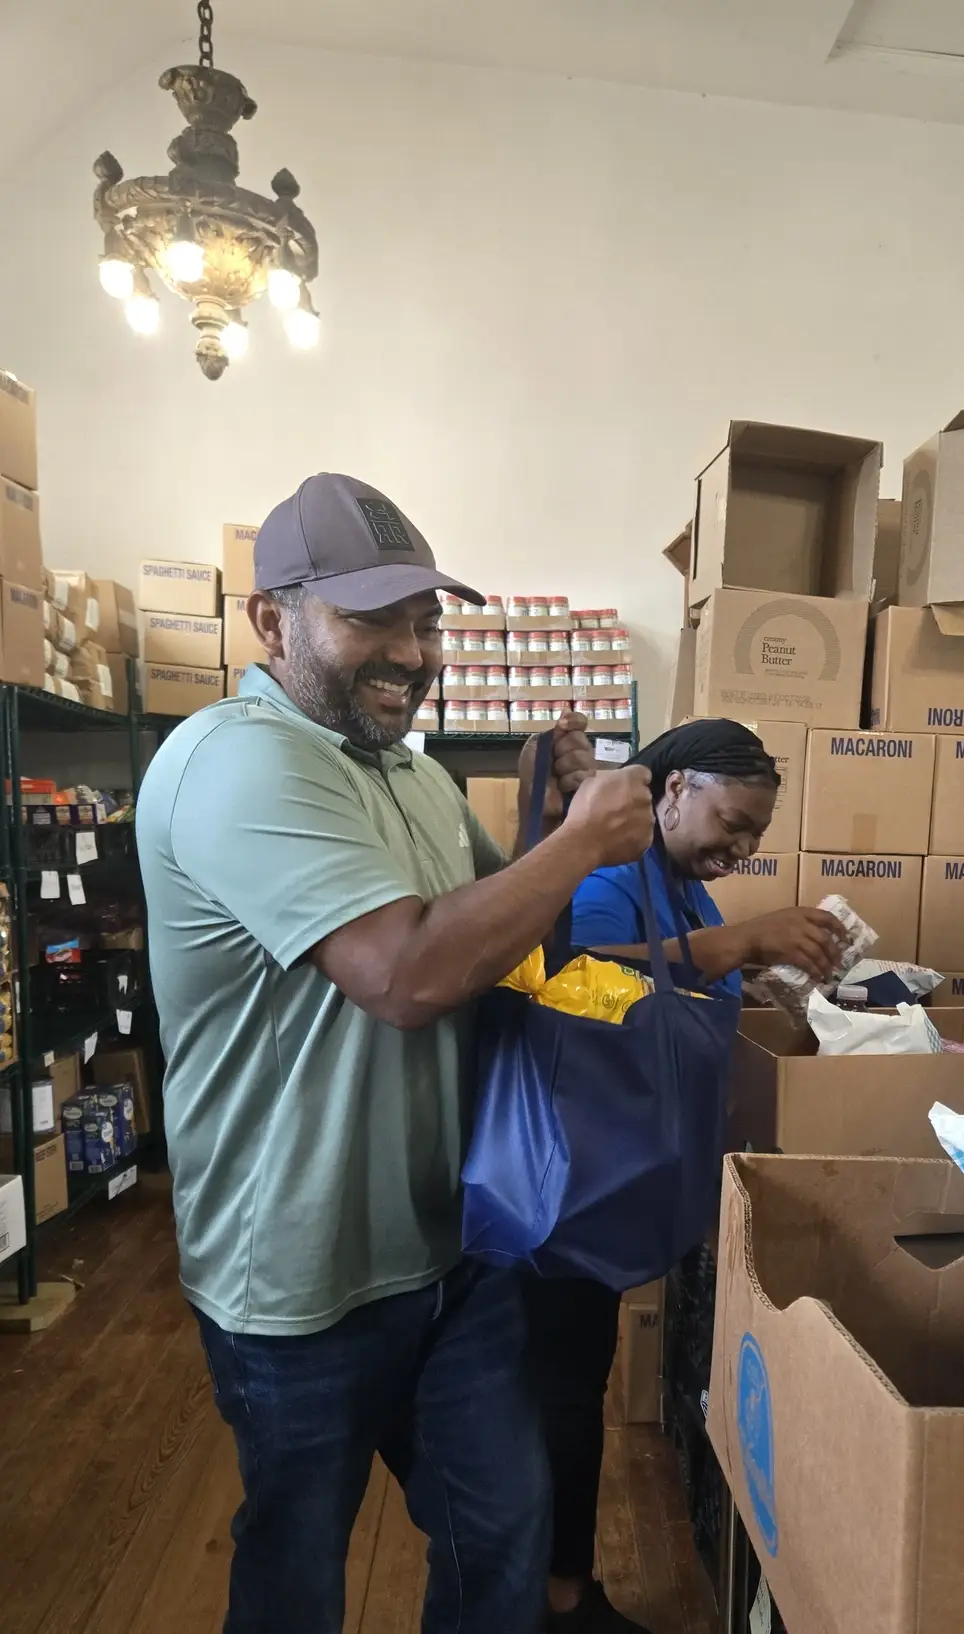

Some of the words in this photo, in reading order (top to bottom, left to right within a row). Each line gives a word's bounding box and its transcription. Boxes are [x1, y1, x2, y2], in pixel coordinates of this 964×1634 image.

[143, 565, 185, 579] SPAGHETTI
[187, 569, 212, 582] SAUCE
[150, 618, 192, 632] SPAGHETTI
[193, 621, 218, 635] SAUCE
[762, 642, 796, 655] Peanut
[763, 636, 787, 644] creamy
[761, 653, 792, 666] Butter
[151, 668, 192, 683] SPAGHETTI
[194, 673, 220, 687] SAUCE
[927, 707, 964, 727] RONI
[831, 737, 913, 758] MACARONI
[775, 755, 790, 763] tter
[731, 858, 778, 876] ARONI
[821, 859, 902, 878] MACARONI
